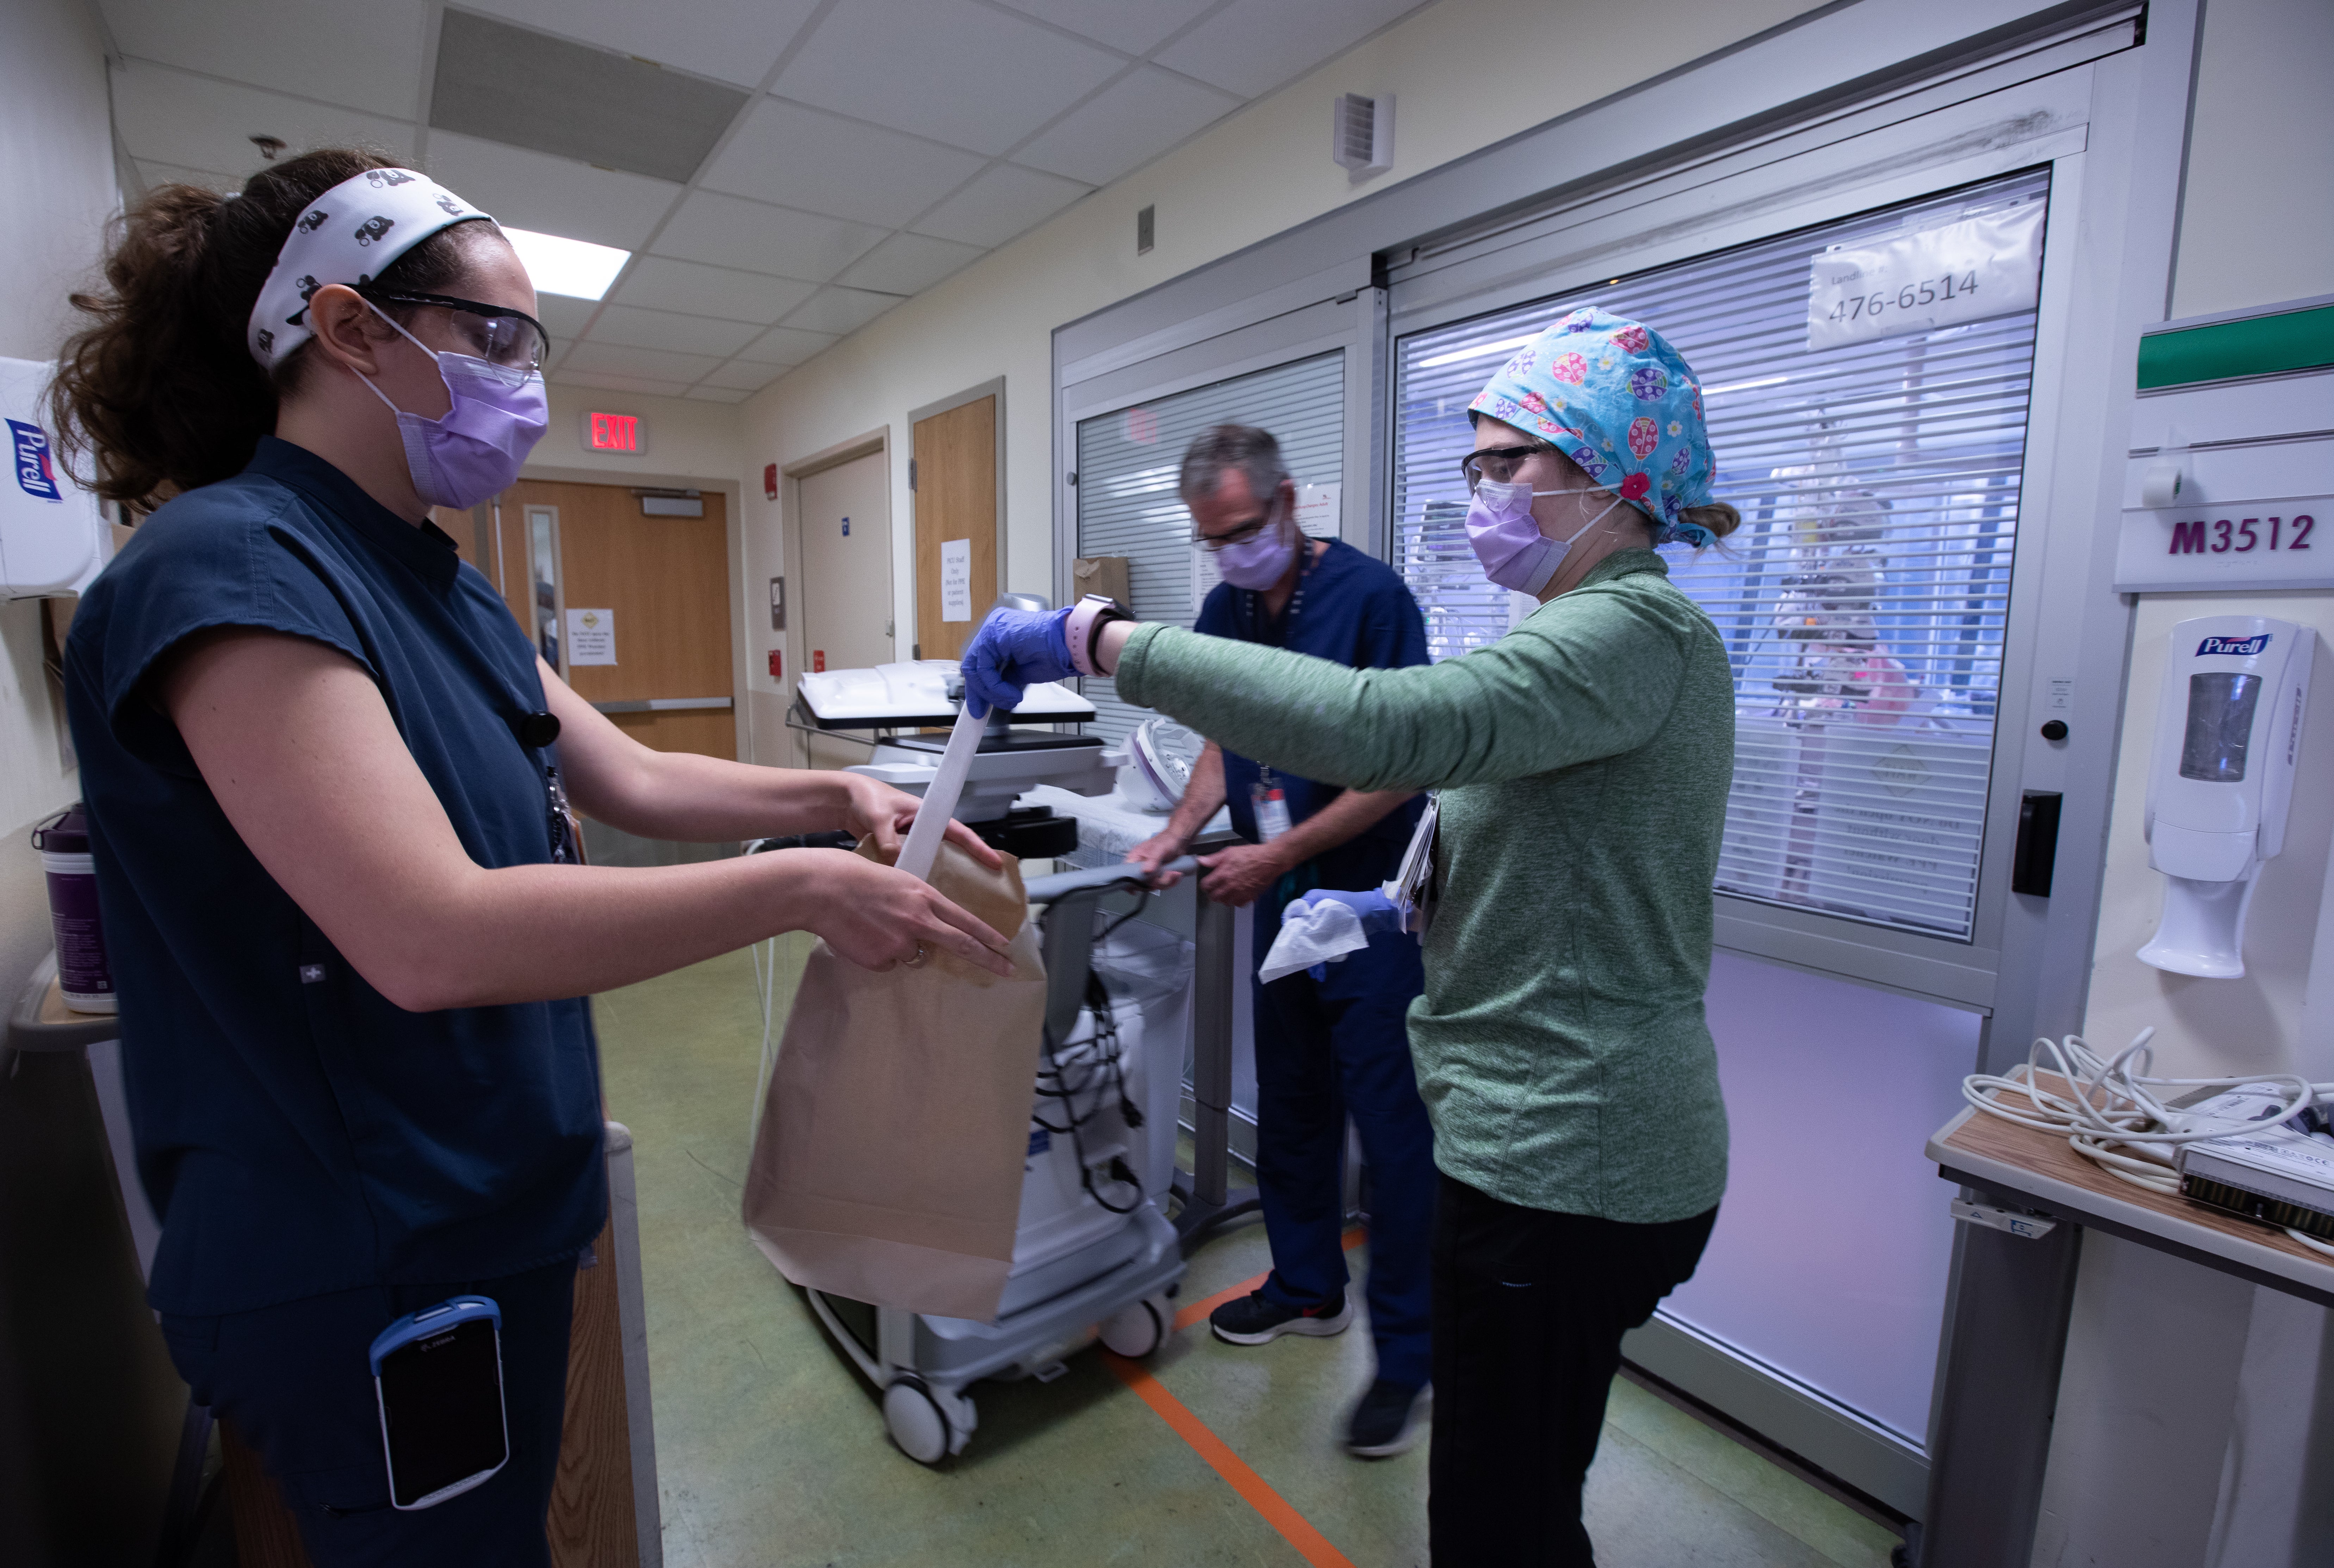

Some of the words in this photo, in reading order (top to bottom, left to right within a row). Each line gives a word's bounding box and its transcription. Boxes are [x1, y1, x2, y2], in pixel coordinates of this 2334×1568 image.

[1831, 268, 1875, 285] Landline
[1829, 270, 1978, 322] 476-6514
[591, 413, 637, 450] EXIT
[17, 429, 51, 493] Purell
[2169, 515, 2315, 554] M3512
[2203, 638, 2263, 653] Purell
